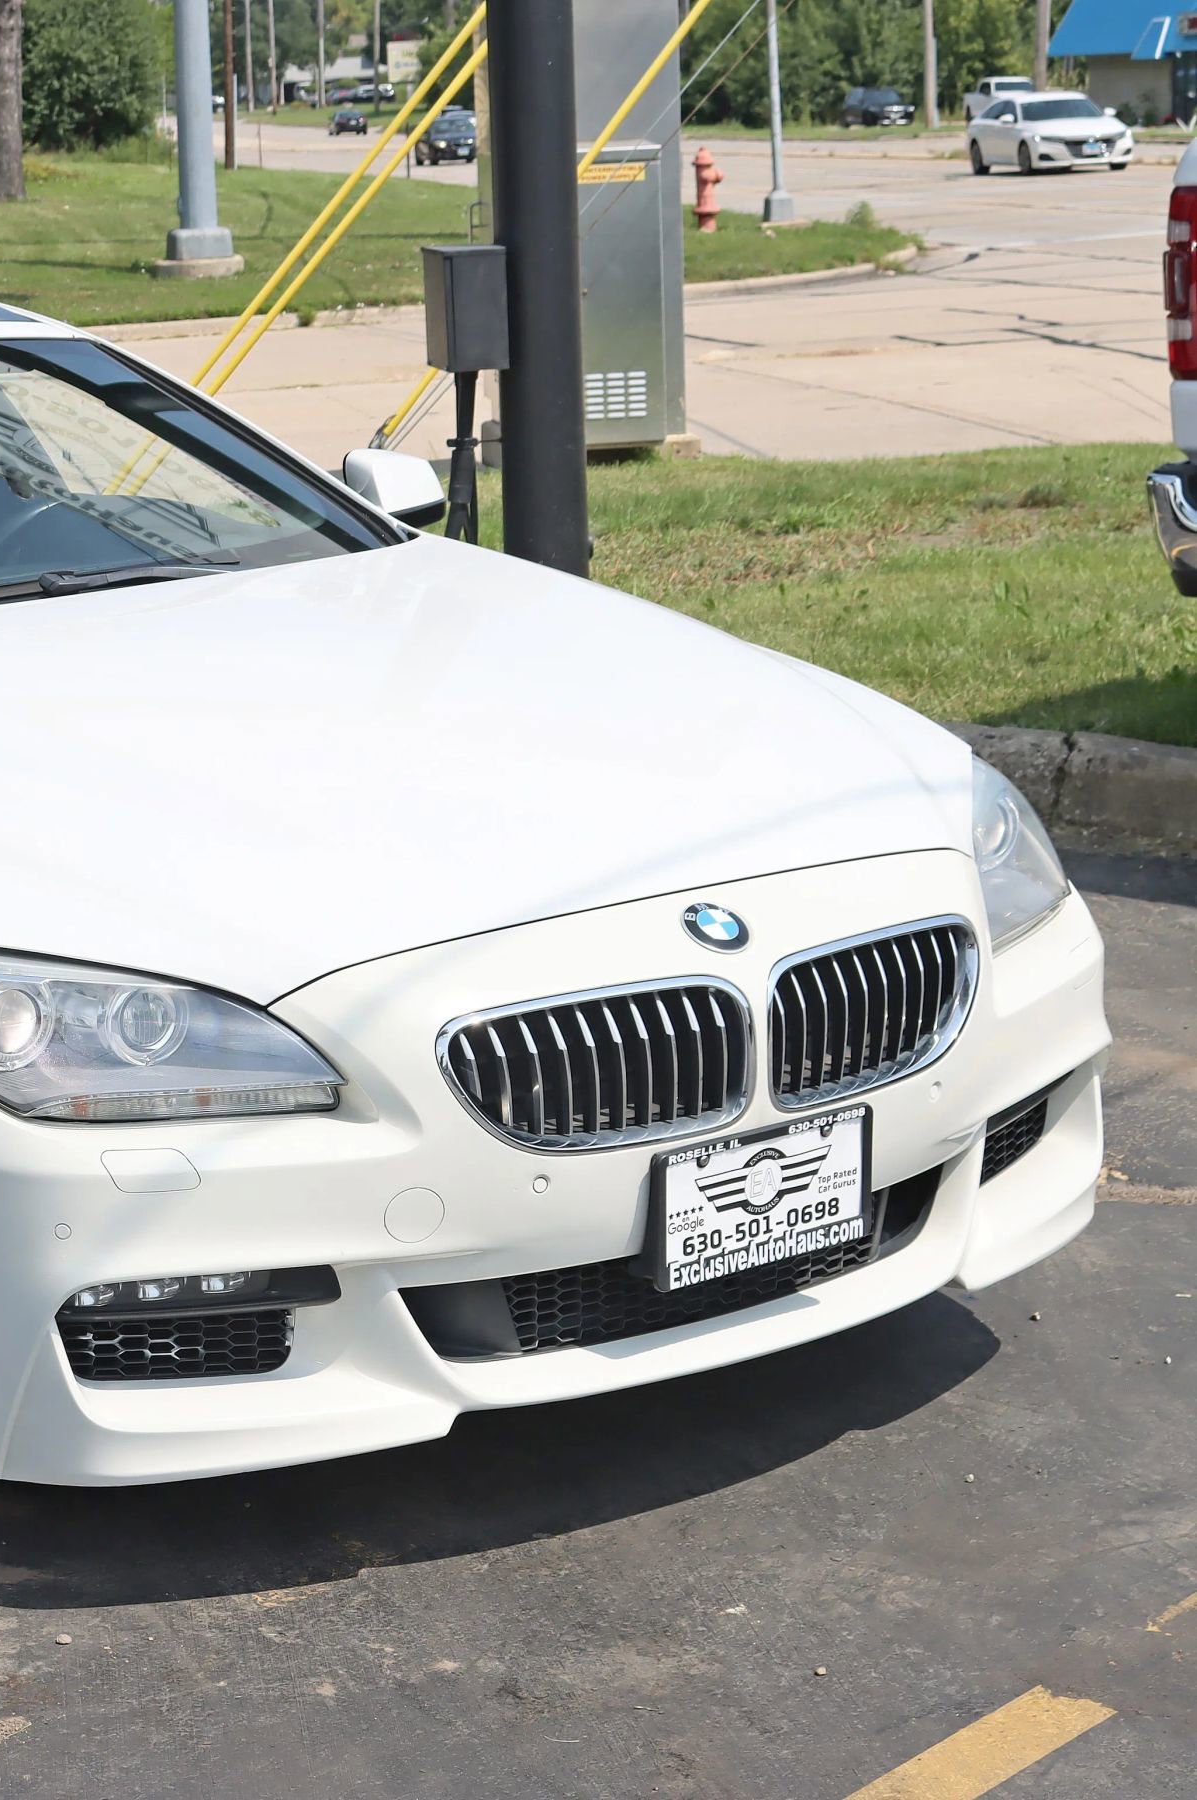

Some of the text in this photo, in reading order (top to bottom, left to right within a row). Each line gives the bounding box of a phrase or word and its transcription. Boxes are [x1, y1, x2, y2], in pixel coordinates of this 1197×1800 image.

[788, 1107, 866, 1134] 630-501-0698
[668, 1138, 742, 1166] ROSELLE, IL
[818, 1167, 857, 1184] Top Rated
[818, 1178, 856, 1193] Car Gurus
[668, 1216, 705, 1235] Google
[682, 1196, 841, 1256] 630-501-0698
[669, 1217, 865, 1290] ExclusiveAutoHaus.com
